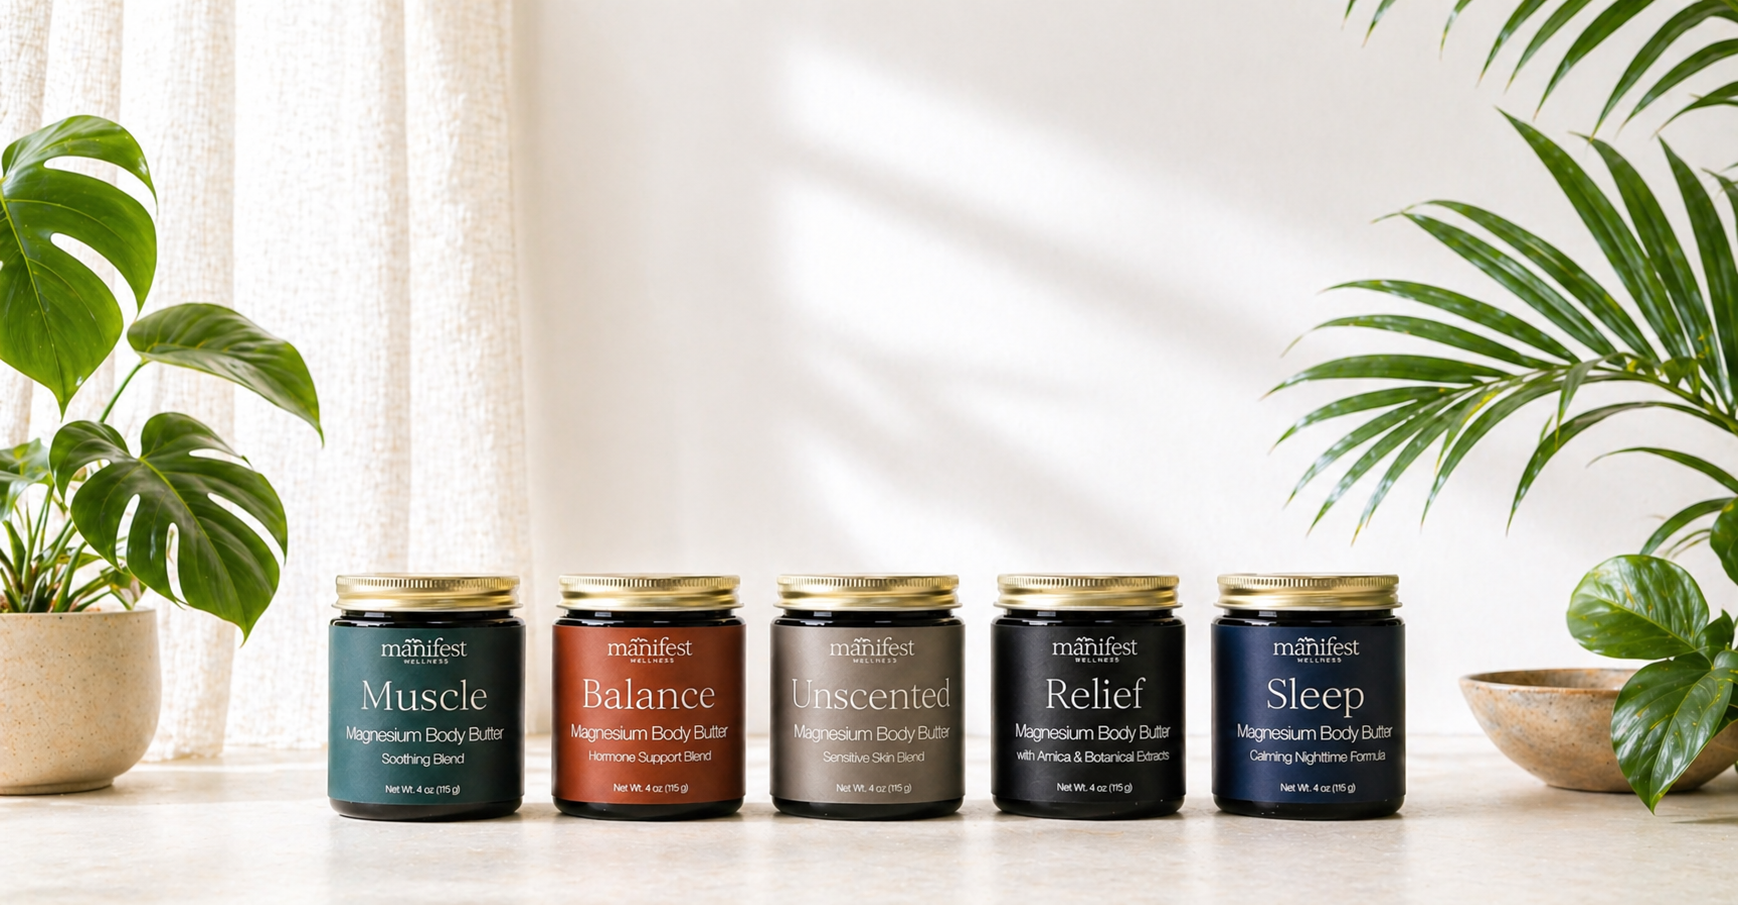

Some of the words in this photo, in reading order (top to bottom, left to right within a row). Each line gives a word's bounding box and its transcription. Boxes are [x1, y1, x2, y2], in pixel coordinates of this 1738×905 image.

[381, 637, 467, 657] manifest
[608, 637, 692, 656] manifest
[830, 637, 915, 656] manifest
[1052, 636, 1138, 656] manifest
[1273, 636, 1359, 656] manifest
[361, 679, 488, 711] Muscle
[583, 678, 715, 710] Balance
[792, 678, 950, 710] Unscented
[1046, 677, 1146, 709] Relief
[1267, 677, 1365, 718] Sleep
[346, 726, 421, 744] Magnesium
[426, 728, 466, 745] Body
[469, 727, 504, 741] Butter
[571, 724, 647, 742] Magnesium
[652, 726, 691, 743] Body
[694, 725, 728, 740] Butter
[794, 724, 872, 742] Magnesium
[877, 726, 915, 743] Body
[918, 725, 950, 740] Butter
[1016, 723, 1093, 742] Magnesium
[1098, 725, 1136, 743] Body
[1140, 724, 1170, 740] Butter
[1238, 724, 1316, 742] Magnesium
[1321, 725, 1359, 743] Body
[1362, 725, 1392, 740] Butter
[382, 753, 430, 767] Soothing
[434, 753, 464, 764] Blend
[589, 751, 635, 762] Hormone
[638, 752, 682, 765] Support
[684, 751, 711, 762] Blend
[823, 751, 870, 763] Sensitive
[872, 752, 894, 763] Skin
[897, 752, 924, 763] Blend
[1017, 750, 1035, 760] with
[1074, 752, 1082, 762] &
[1085, 751, 1134, 762] Botanical
[1137, 751, 1170, 761] Extracts
[1250, 750, 1292, 765] Calming
[1295, 752, 1348, 765] Nighttime
[1351, 751, 1386, 762] Formula
[452, 786, 460, 795] g)
[613, 784, 628, 792] Net
[645, 784, 650, 792] 4
[681, 783, 688, 793] g)
[836, 784, 851, 792] Net
[904, 784, 911, 794] g)
[1057, 783, 1072, 791] Net
[1124, 783, 1132, 793] g)
[1280, 783, 1295, 791] Net
[1348, 783, 1356, 793] g)
